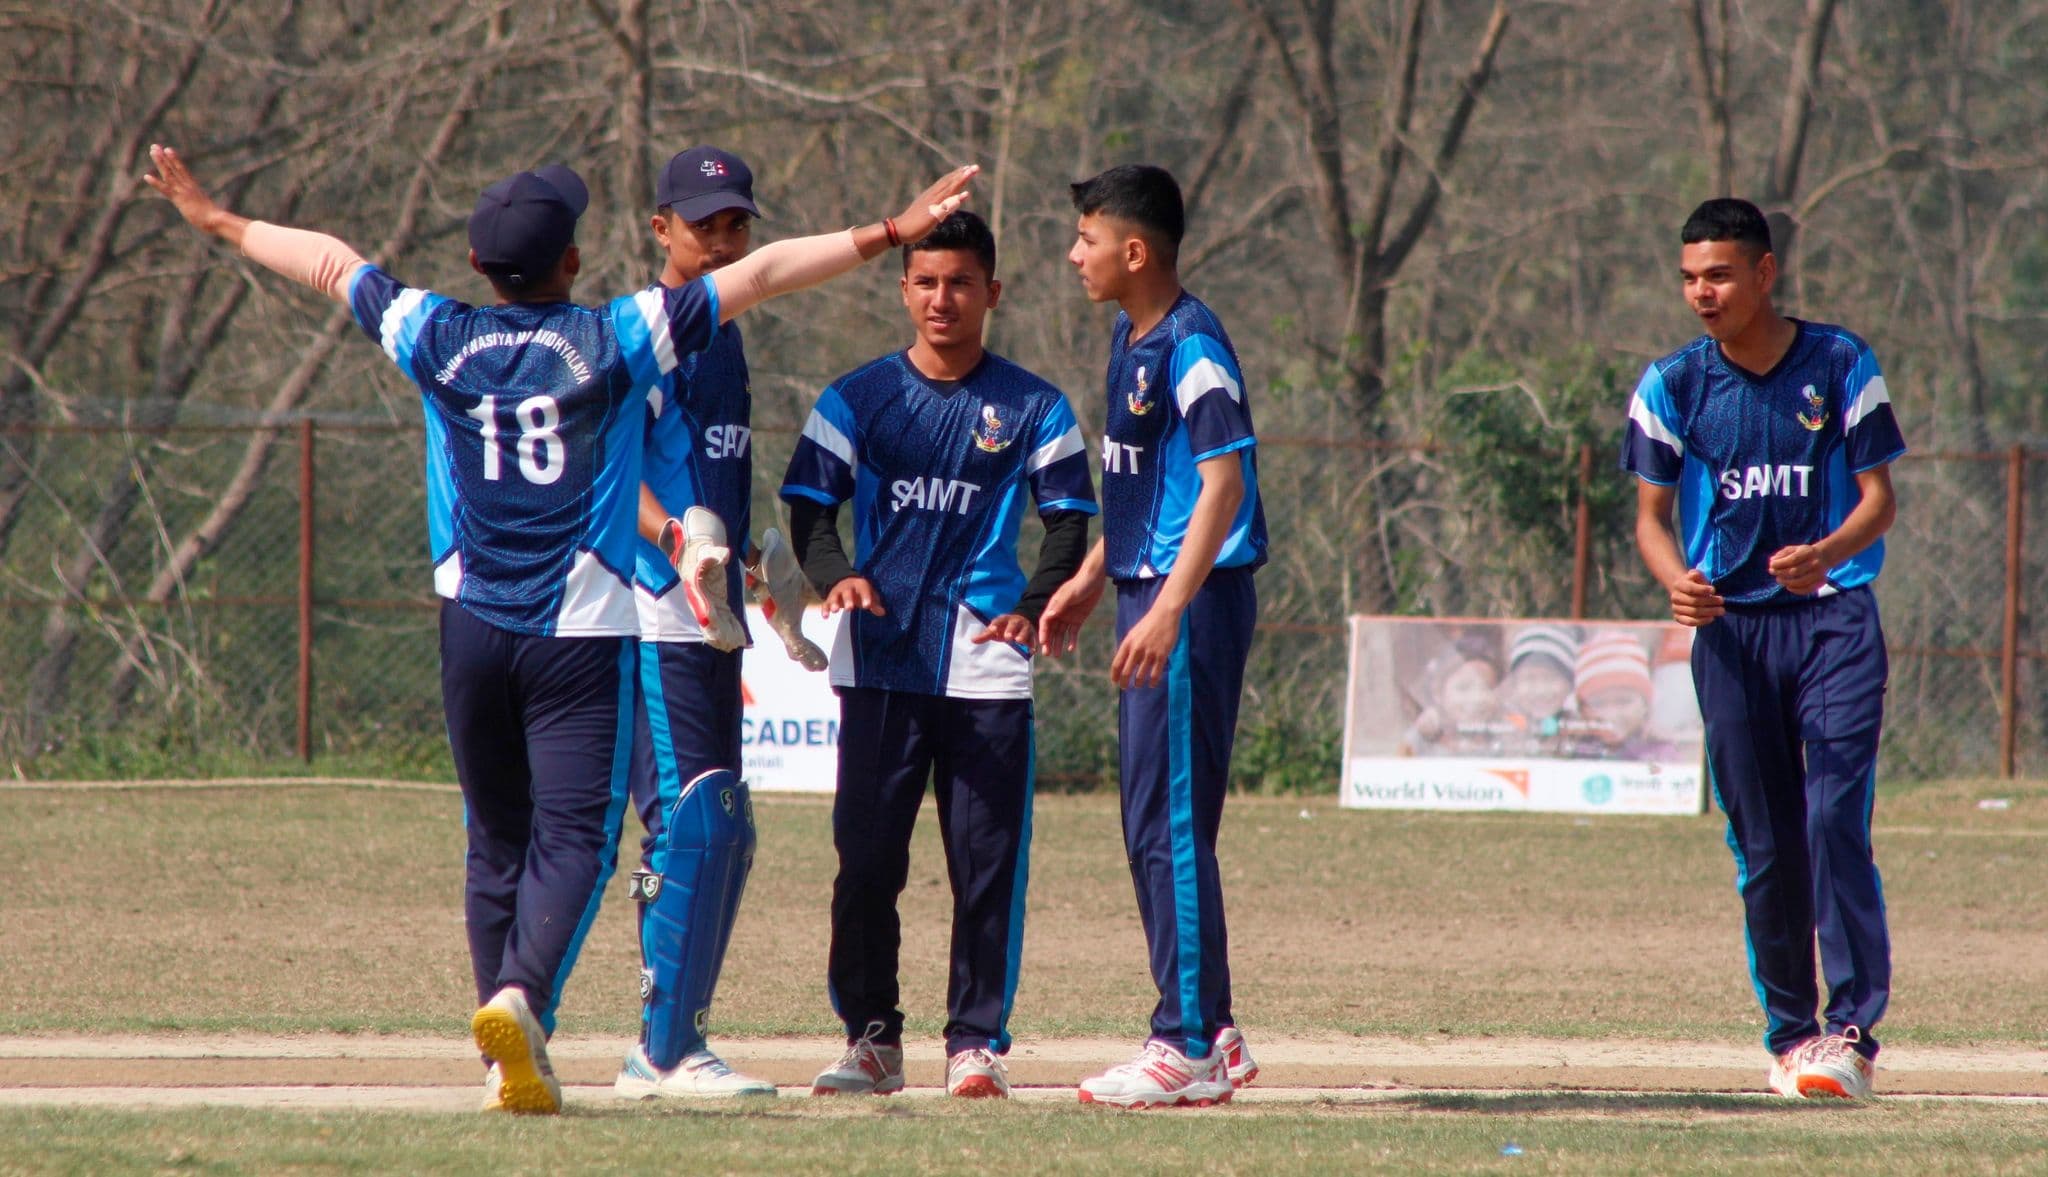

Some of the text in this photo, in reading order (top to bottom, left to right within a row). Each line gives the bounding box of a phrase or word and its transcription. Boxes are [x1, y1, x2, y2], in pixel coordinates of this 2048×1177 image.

[466, 394, 565, 485] 18
[1102, 434, 1144, 475] MT
[890, 476, 981, 515] SAMT
[1720, 463, 1814, 500] SAMT
[1353, 781, 1504, 802] World Vision
